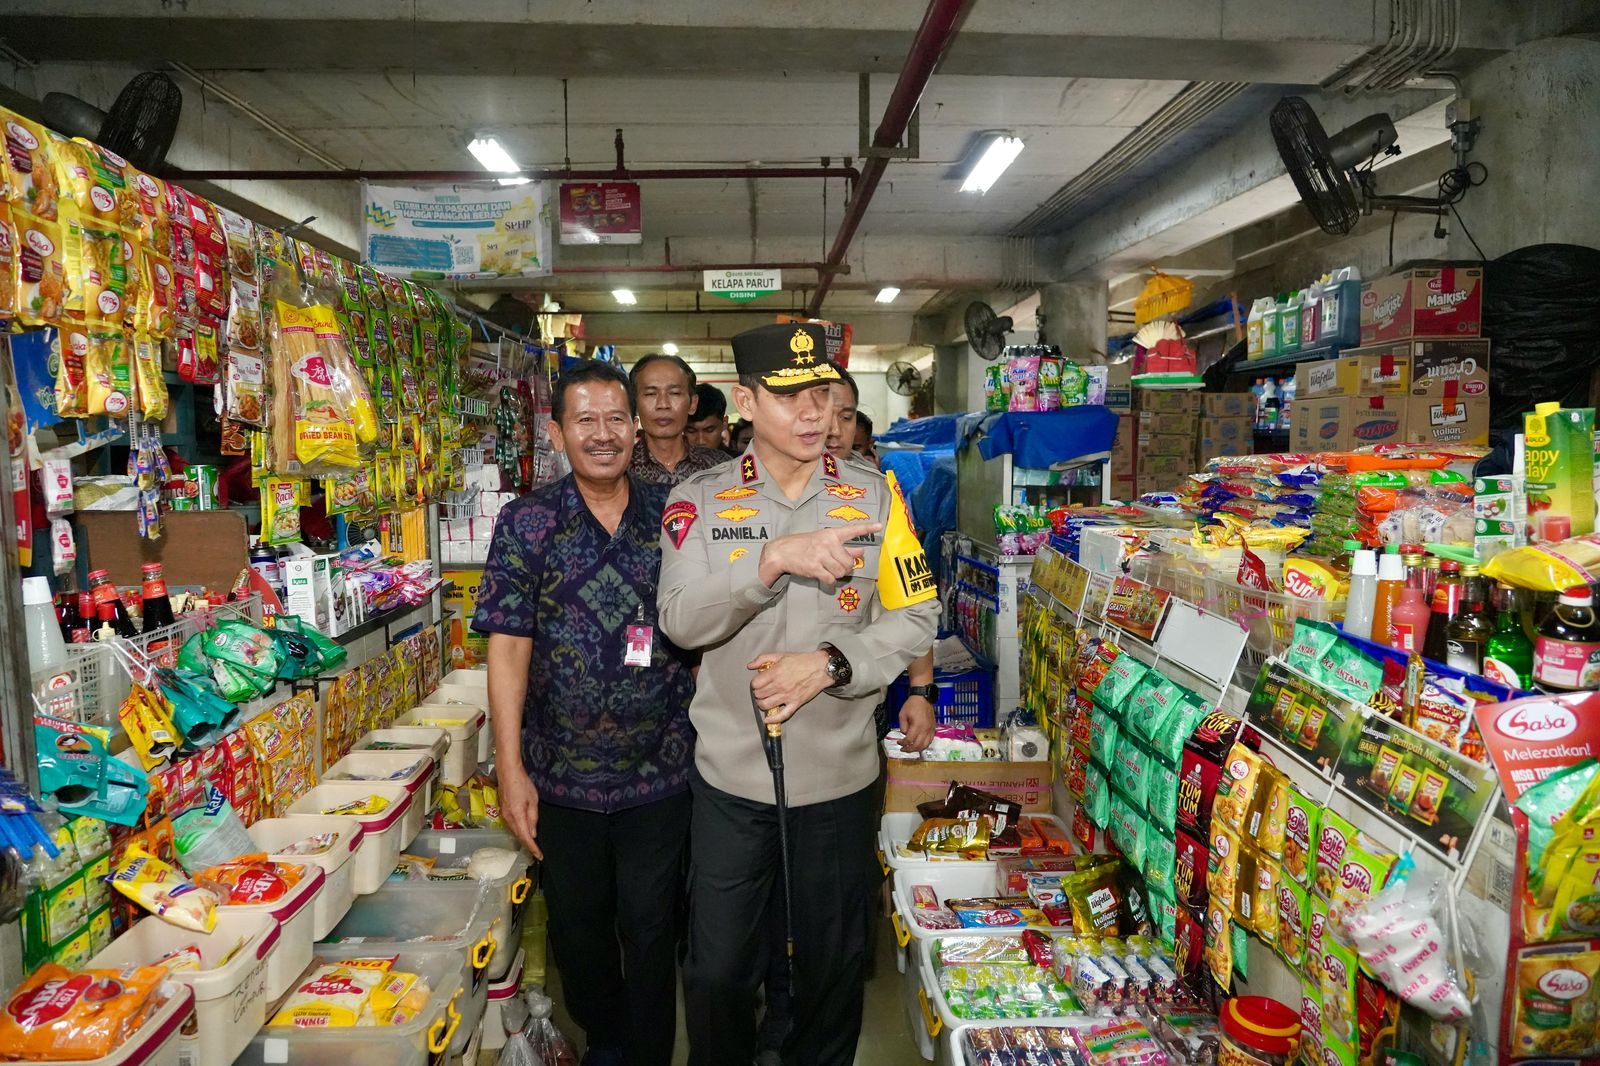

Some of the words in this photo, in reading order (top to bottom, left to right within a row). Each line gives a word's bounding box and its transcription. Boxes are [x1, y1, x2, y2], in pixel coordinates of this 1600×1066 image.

[394, 200, 444, 211] STABILISASI
[445, 201, 489, 211] PASOKAN
[491, 201, 511, 211] DAN
[403, 210, 433, 219] HARGA
[433, 210, 472, 220] PANGAN
[472, 210, 504, 219] BERAS
[505, 220, 532, 230] SPHP
[711, 279, 744, 289] KELAPA
[746, 278, 774, 288] PARUT
[1373, 294, 1402, 320] Malkist
[1427, 289, 1467, 307] Malkist
[1427, 358, 1477, 378] Cream
[1310, 369, 1335, 388] Wafello
[299, 431, 321, 440] DRIED
[323, 431, 342, 440] BEAN
[1432, 427, 1466, 438] Italian
[1525, 450, 1560, 466] appy
[275, 491, 295, 504] Racik
[712, 526, 768, 540] DANIEL.A
[1296, 644, 1318, 656] ANTAKA
[1289, 678, 1311, 694] Rempah
[1336, 667, 1369, 689] ANTAKA
[1202, 715, 1231, 734] TUM
[1509, 709, 1567, 734] Sasa
[1360, 741, 1379, 753] BARU
[1503, 743, 1592, 762] Melezatkan!
[1361, 725, 1391, 741] Kekayaan
[1391, 734, 1424, 756] Rempah
[1424, 748, 1450, 770] Murni
[1447, 766, 1477, 792] Indonesia
[1510, 769, 1535, 782] MSG
[1181, 779, 1202, 803] TUM
[1178, 792, 1198, 816] TUM
[116, 864, 138, 883] Blue
[1176, 859, 1194, 884] TUM
[1340, 863, 1370, 894] Sajiku
[247, 872, 274, 902] ABC
[1091, 892, 1111, 909] Wafello
[1094, 909, 1118, 927] Italian
[1547, 973, 1584, 992] Sasa
[22, 980, 68, 1017] ABC
